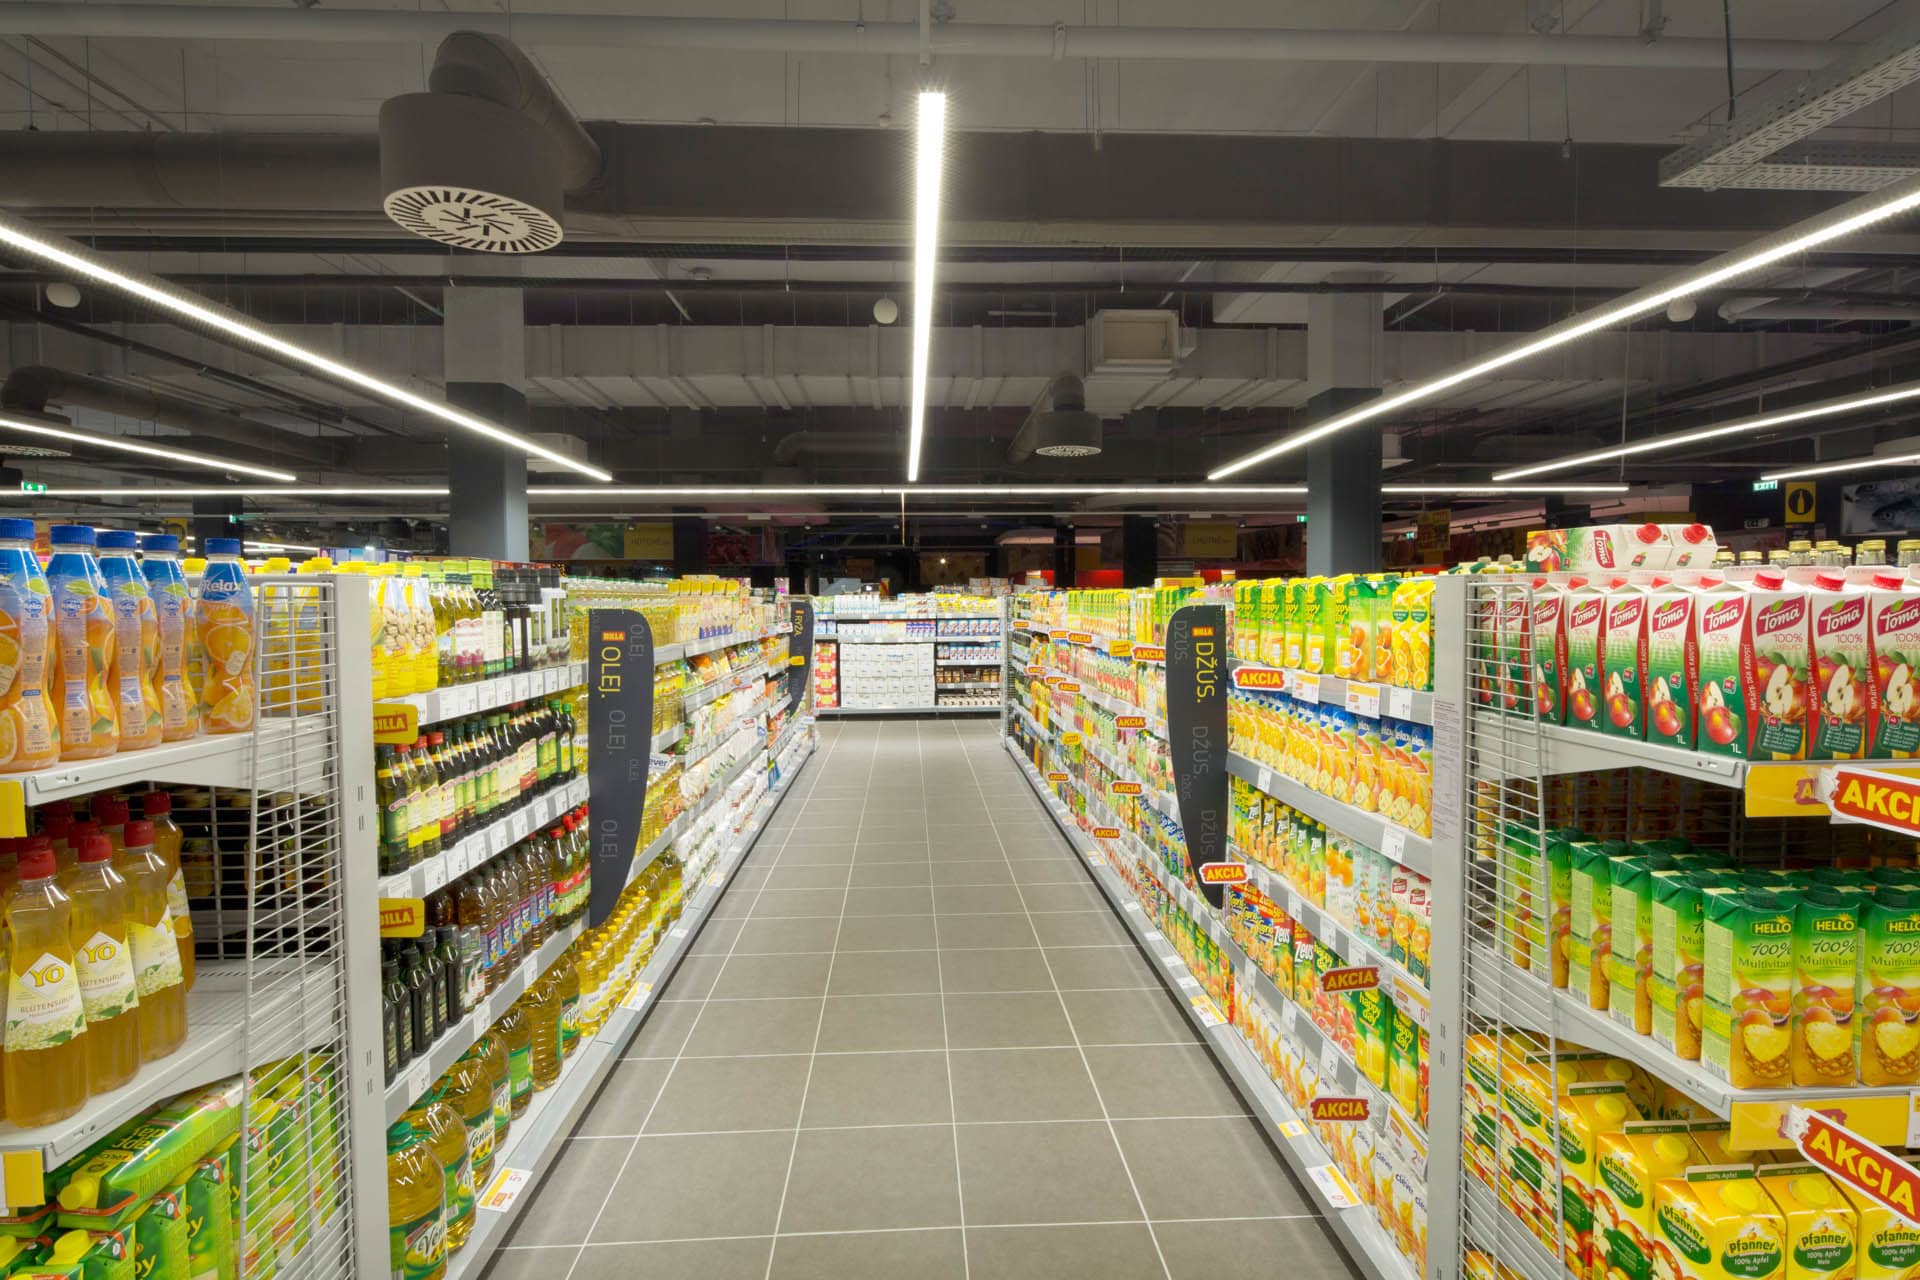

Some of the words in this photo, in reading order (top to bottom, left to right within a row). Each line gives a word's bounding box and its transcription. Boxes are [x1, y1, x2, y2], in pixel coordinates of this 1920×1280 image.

[1595, 532, 1610, 565] Toma
[202, 580, 241, 592] Relax
[1573, 607, 1598, 626] Toma
[1611, 607, 1638, 628] Toma
[1655, 607, 1685, 629] Toma
[1705, 608, 1739, 630] Toma
[1759, 606, 1800, 632] Toma
[1821, 607, 1861, 633] Toma
[1070, 634, 1091, 643] AKCIA
[1774, 633, 1803, 643] 100%
[1835, 633, 1863, 643] 100%
[1136, 650, 1164, 659] AKCIA
[598, 646, 621, 698] OLEJ.
[1196, 643, 1218, 704] DŽÚS.
[1240, 672, 1281, 685] AKCIA
[1118, 718, 1144, 727] AKCIA
[607, 709, 626, 755] OLEJ.
[1628, 726, 1638, 735] 1L
[1676, 734, 1686, 744] 1L
[1731, 743, 1742, 753] 1L
[1113, 783, 1141, 793] AKCIA
[1095, 829, 1119, 838] AKCIA
[1207, 868, 1244, 881] AKCIA
[1755, 923, 1792, 934] HELLO
[1816, 920, 1855, 932] HELLO
[1274, 925, 1290, 946] Zeus
[83, 941, 116, 964] YO
[1295, 941, 1314, 962] Zeus
[1811, 940, 1855, 957] 100%
[29, 963, 65, 987] YO
[1326, 970, 1375, 990] AKCIA
[1316, 1102, 1365, 1117] AKCIA
[1375, 1151, 1393, 1171] clever
[1722, 1172, 1737, 1180] Apfel
[1810, 1128, 1916, 1216] AKCIA
[1395, 1173, 1414, 1195] clever
[1806, 1250, 1824, 1259] 100%
[1824, 1249, 1842, 1259] Apfel
[1881, 1248, 1899, 1256] 100%
[1900, 1246, 1916, 1257] Apfel
[1734, 1257, 1752, 1266] 100%
[1752, 1256, 1769, 1265] Apfel
